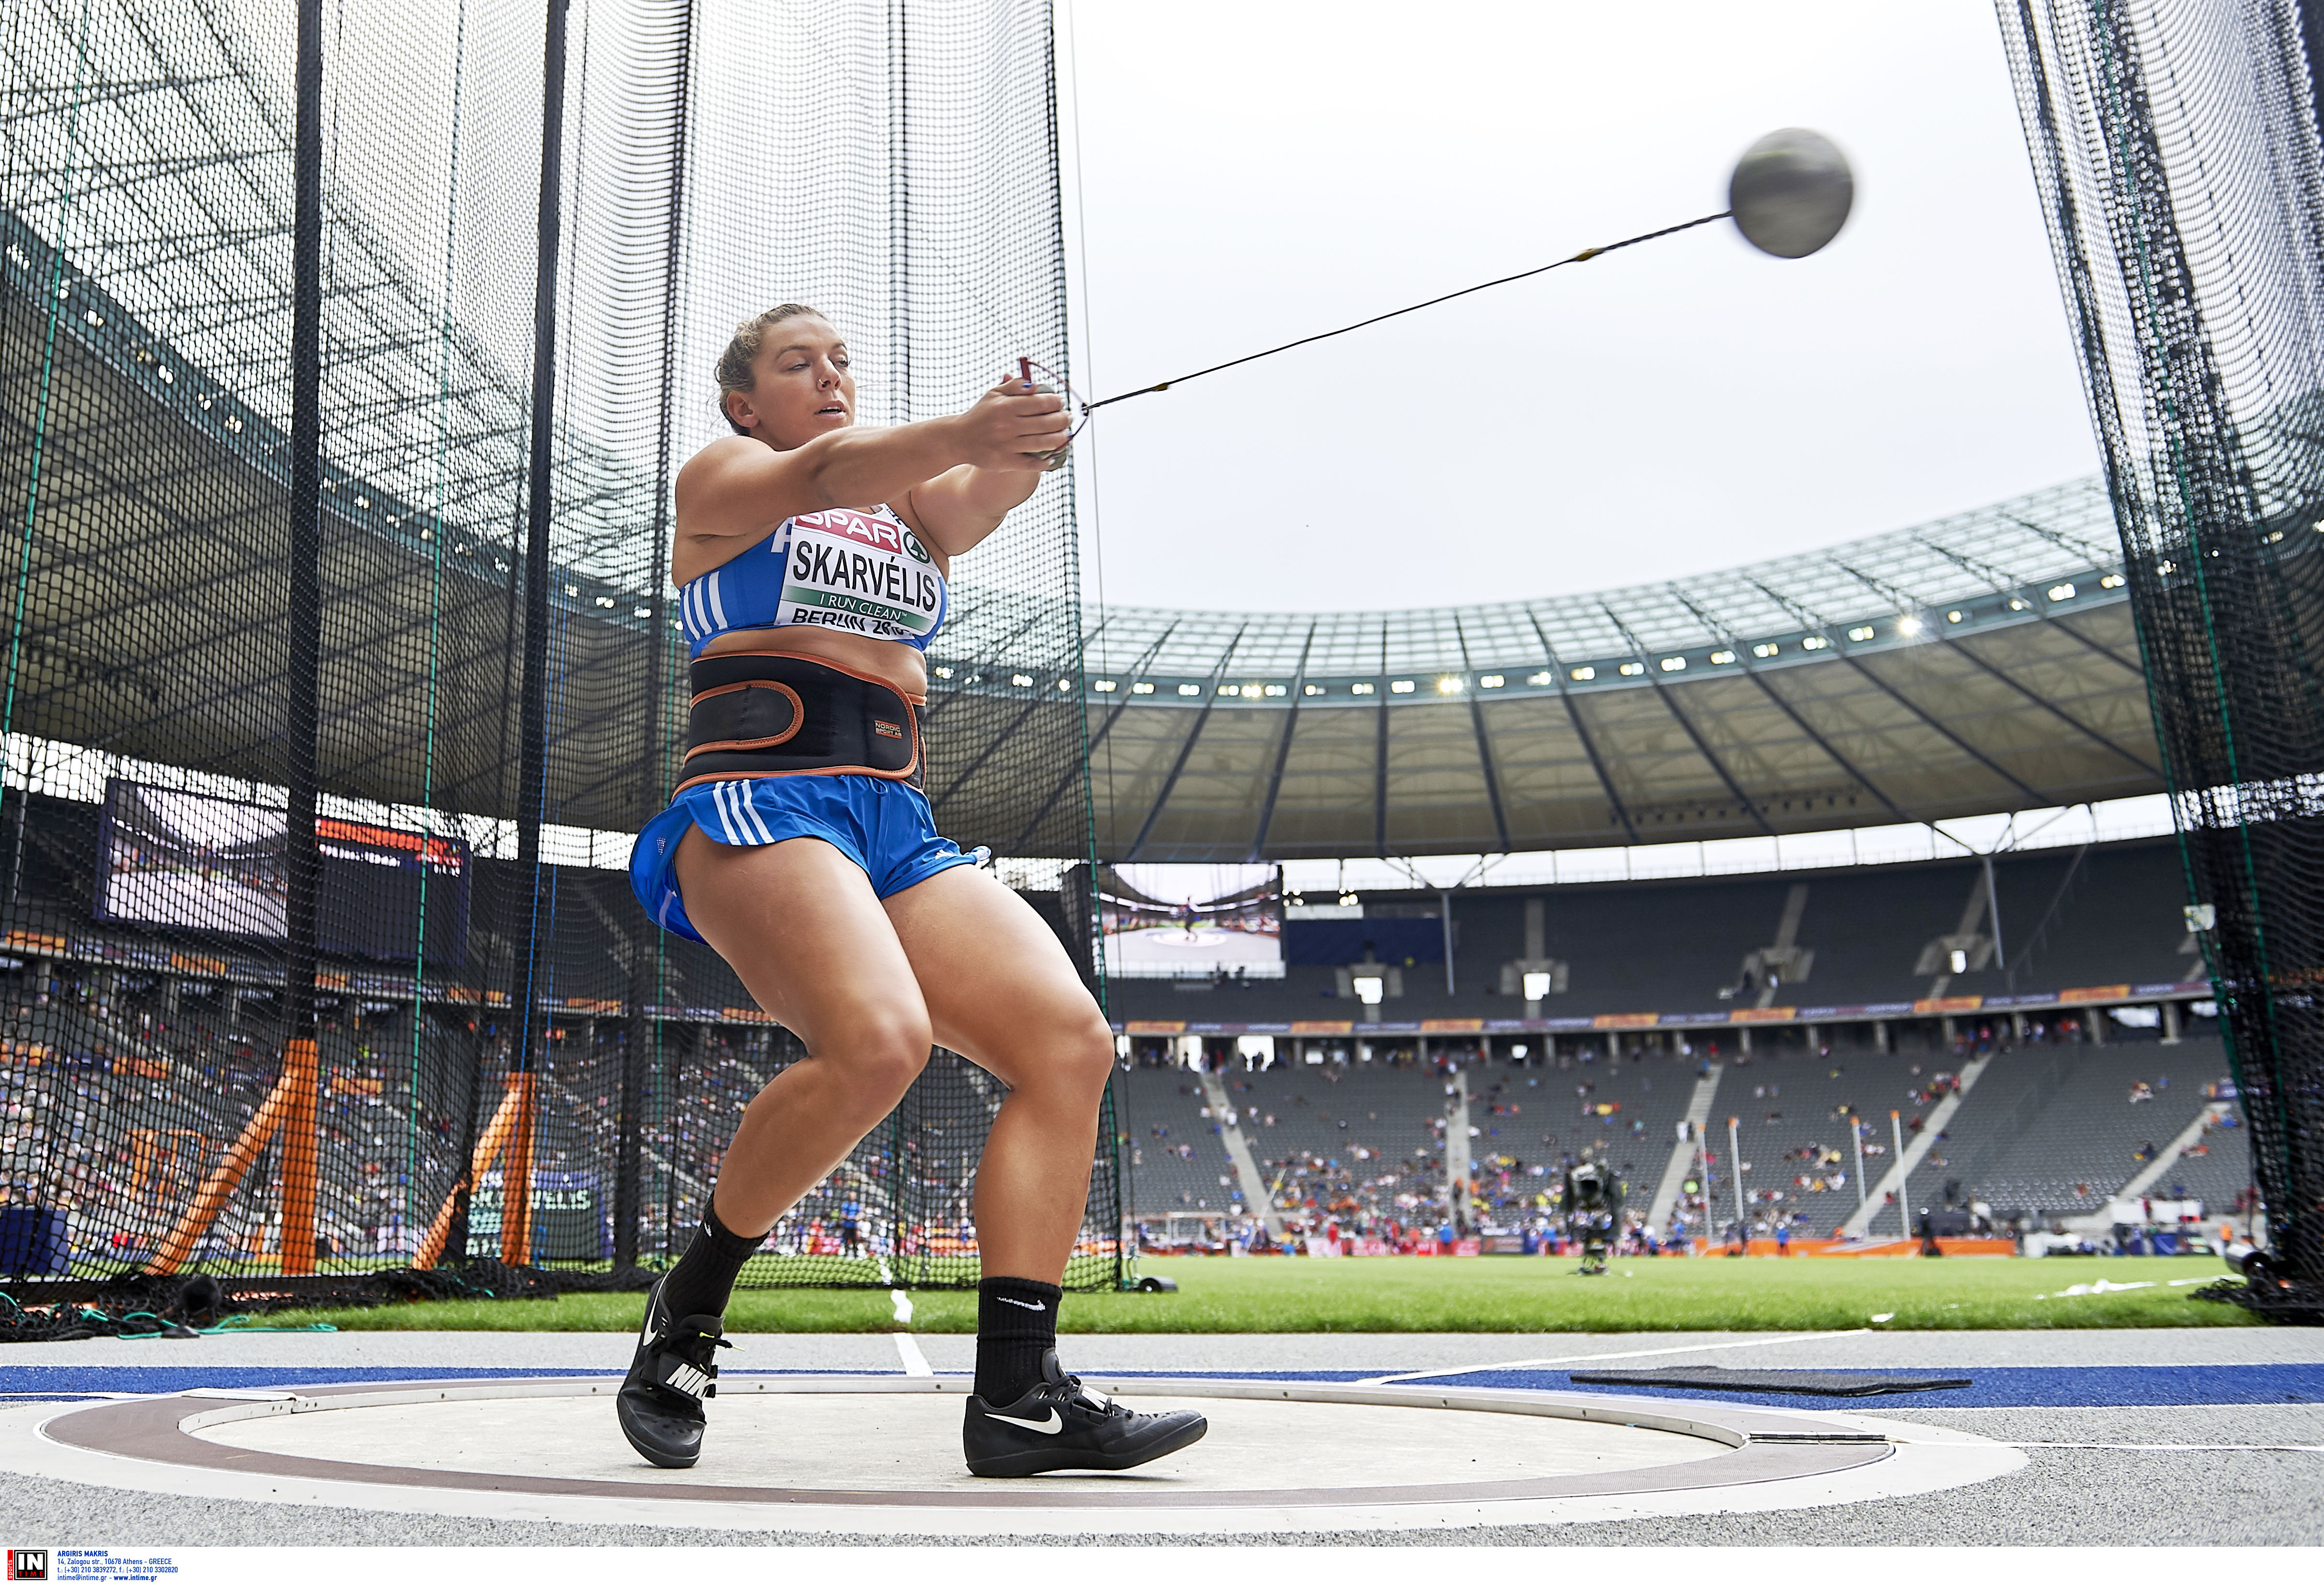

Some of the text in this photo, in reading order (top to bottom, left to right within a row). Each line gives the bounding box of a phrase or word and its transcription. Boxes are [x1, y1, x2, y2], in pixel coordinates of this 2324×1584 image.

[793, 541, 936, 612] SKARVÉLIS
[820, 593, 825, 605] I
[828, 595, 857, 610] RUN
[792, 608, 865, 632] BERLIN
[875, 722, 900, 733] NORDIC
